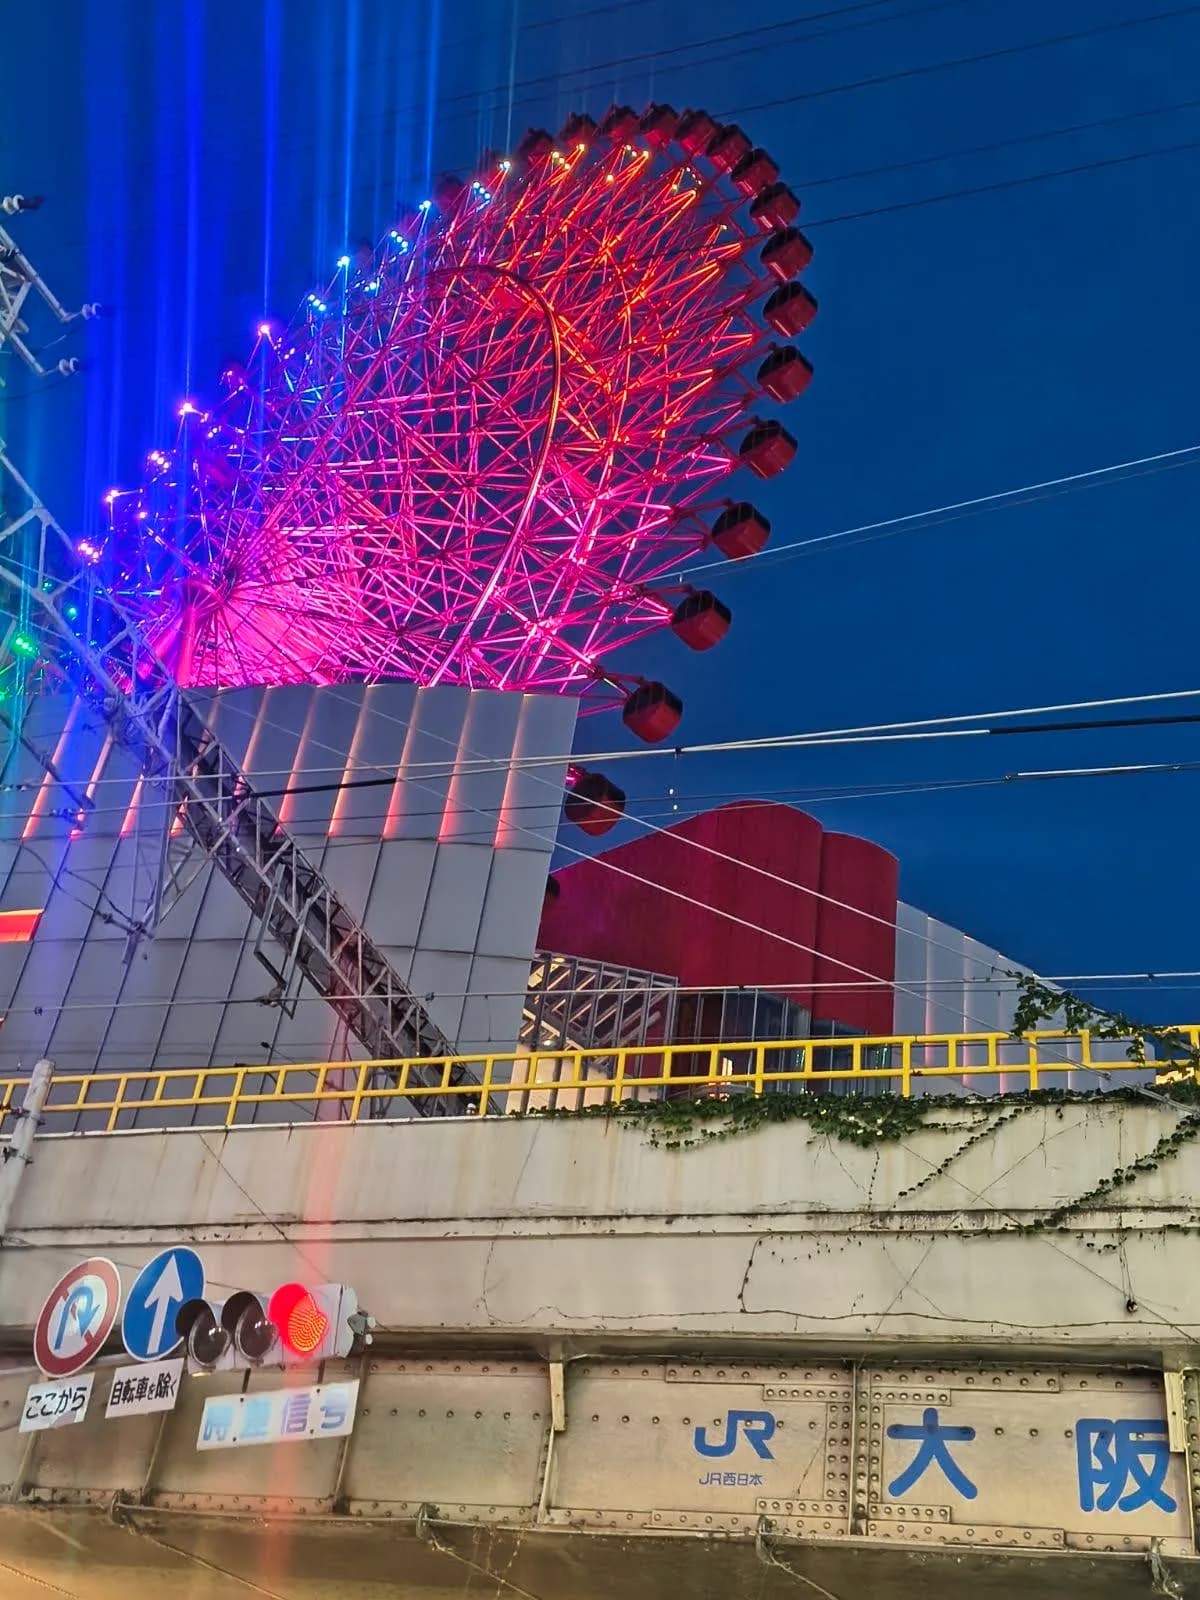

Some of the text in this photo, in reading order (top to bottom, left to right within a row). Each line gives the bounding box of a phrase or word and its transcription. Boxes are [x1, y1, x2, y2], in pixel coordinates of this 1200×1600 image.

[25, 1386, 88, 1420] ここから
[110, 1372, 177, 1406] 自転車を除く
[694, 1410, 776, 1460] JR
[886, 1407, 1178, 1513] 大阪
[698, 1471, 763, 1487] JR西日本
